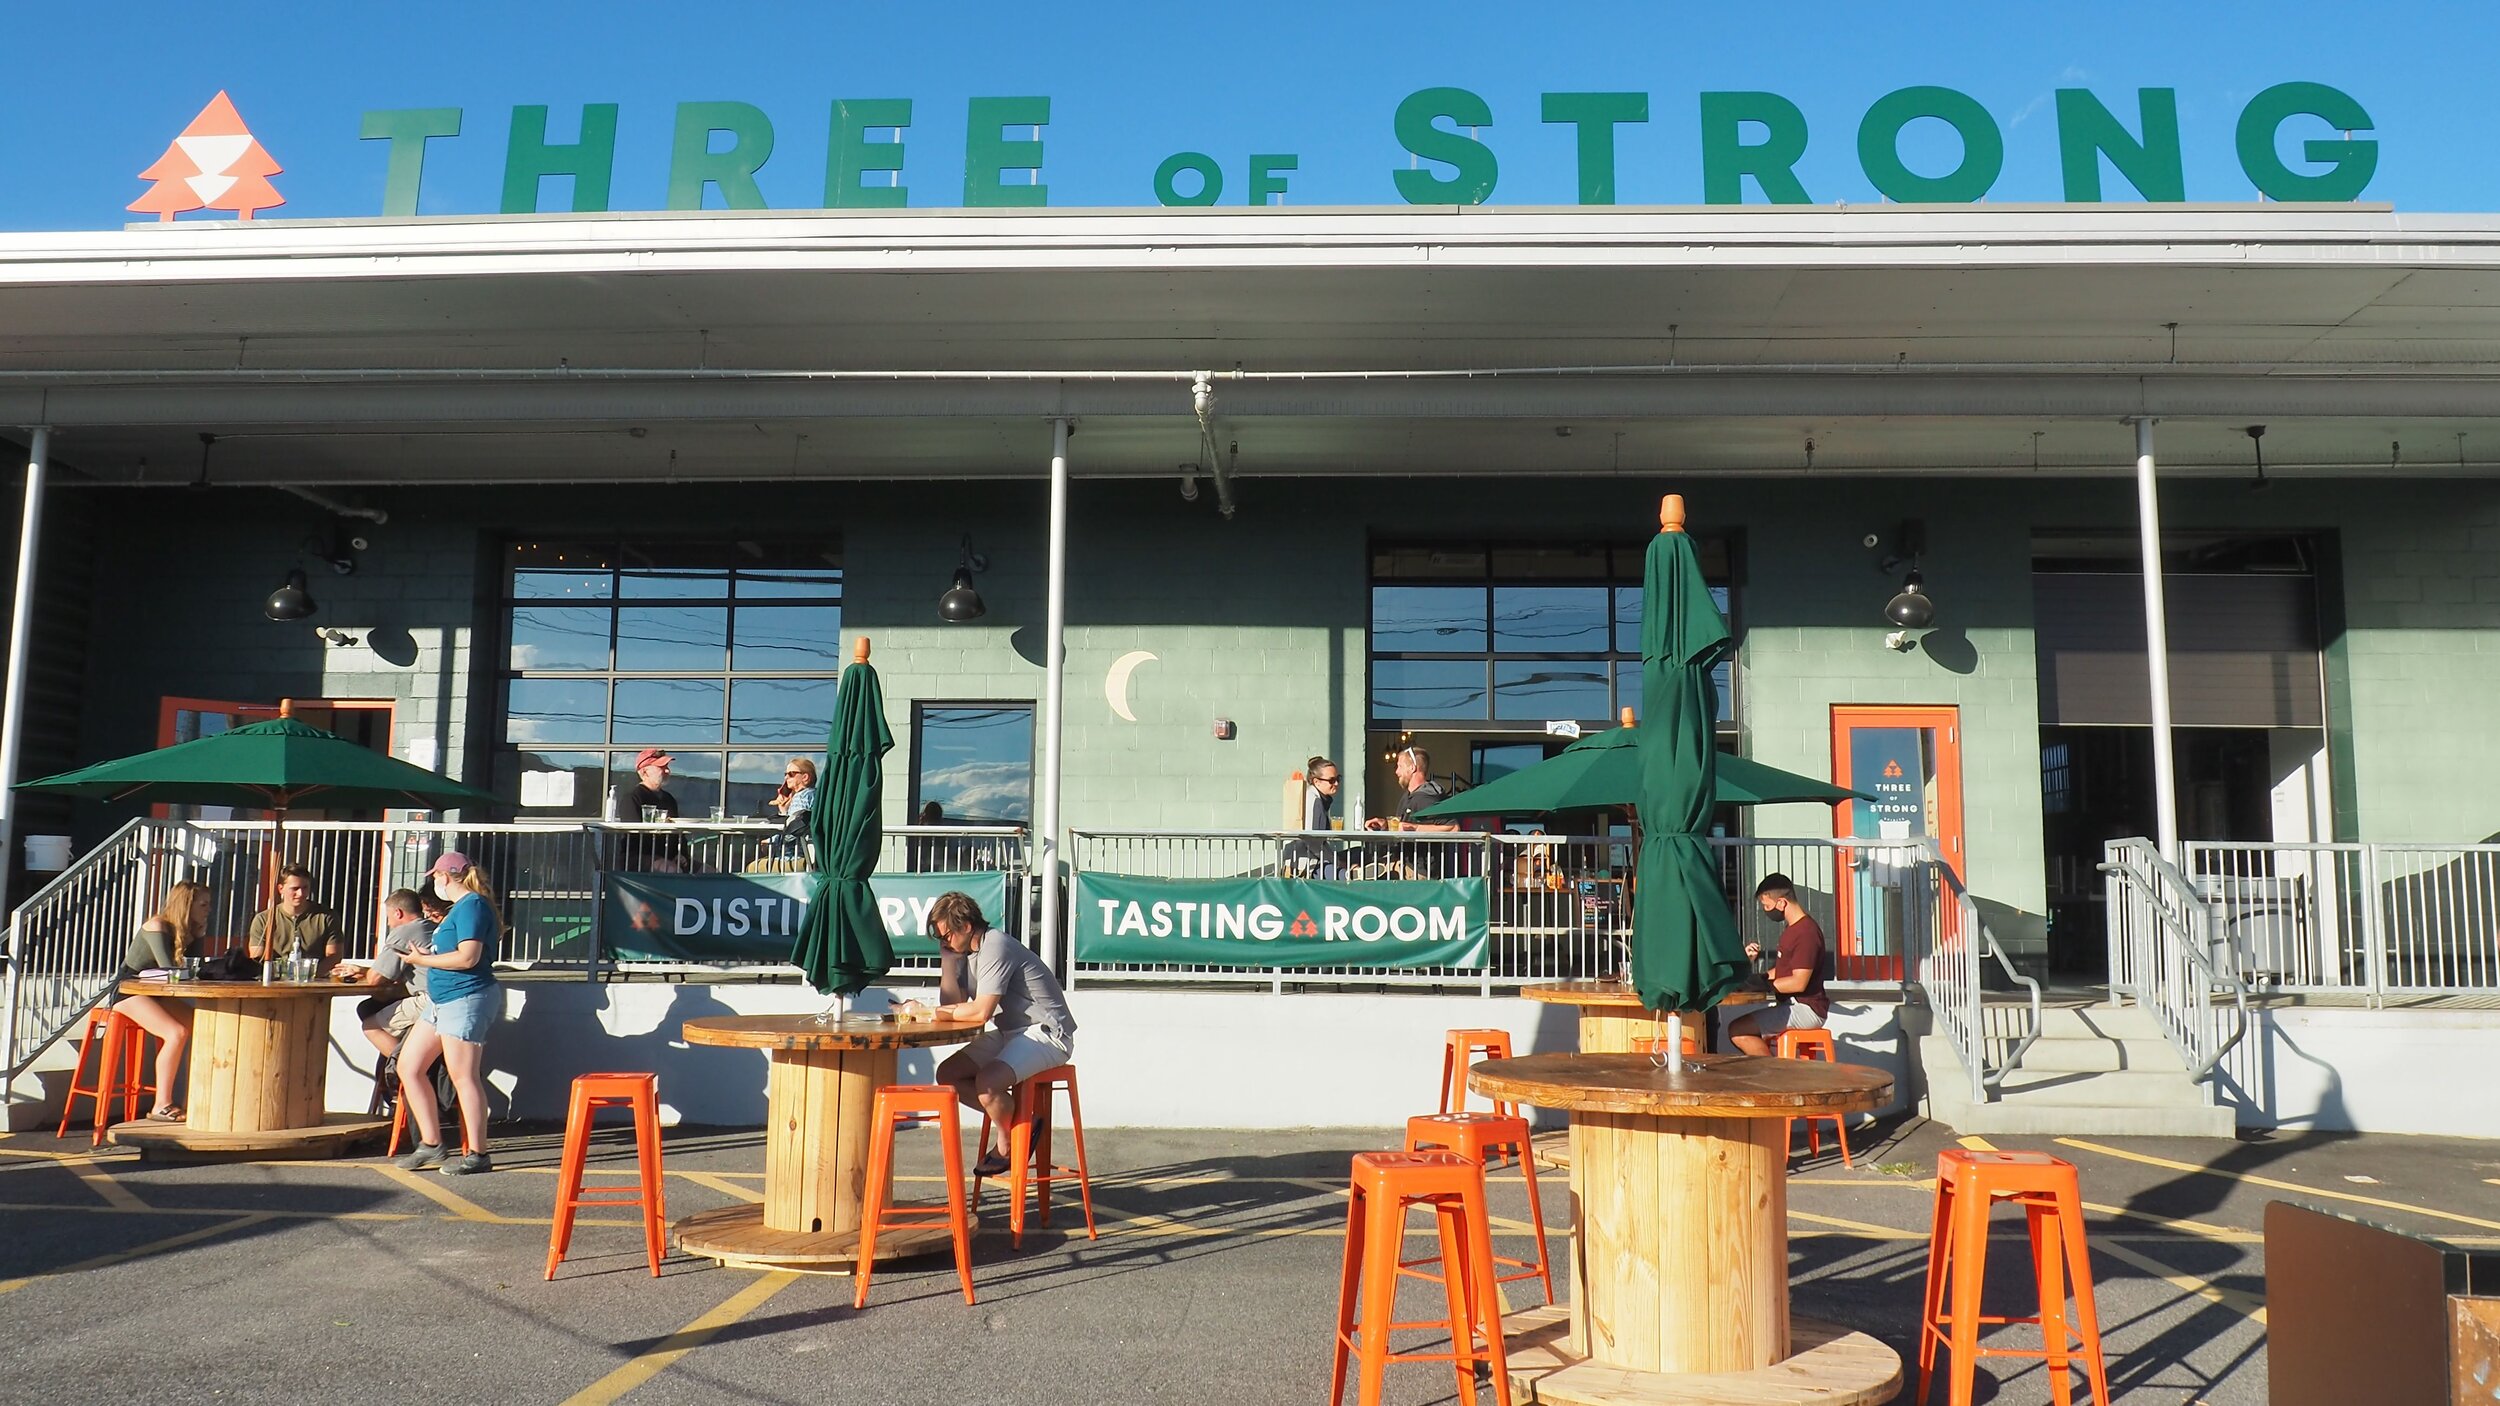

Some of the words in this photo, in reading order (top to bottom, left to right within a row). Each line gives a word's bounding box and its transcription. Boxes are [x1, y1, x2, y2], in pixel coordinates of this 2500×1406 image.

[360, 96, 1051, 216] THREE
[1153, 151, 1299, 207] OF
[1392, 81, 2379, 206] STRONG
[1875, 783, 1912, 792] THREE
[1870, 804, 1918, 813] STRONG
[674, 897, 938, 936] DISTIRY
[1098, 899, 1285, 941] TASTING
[1324, 905, 1467, 942] ROOM
